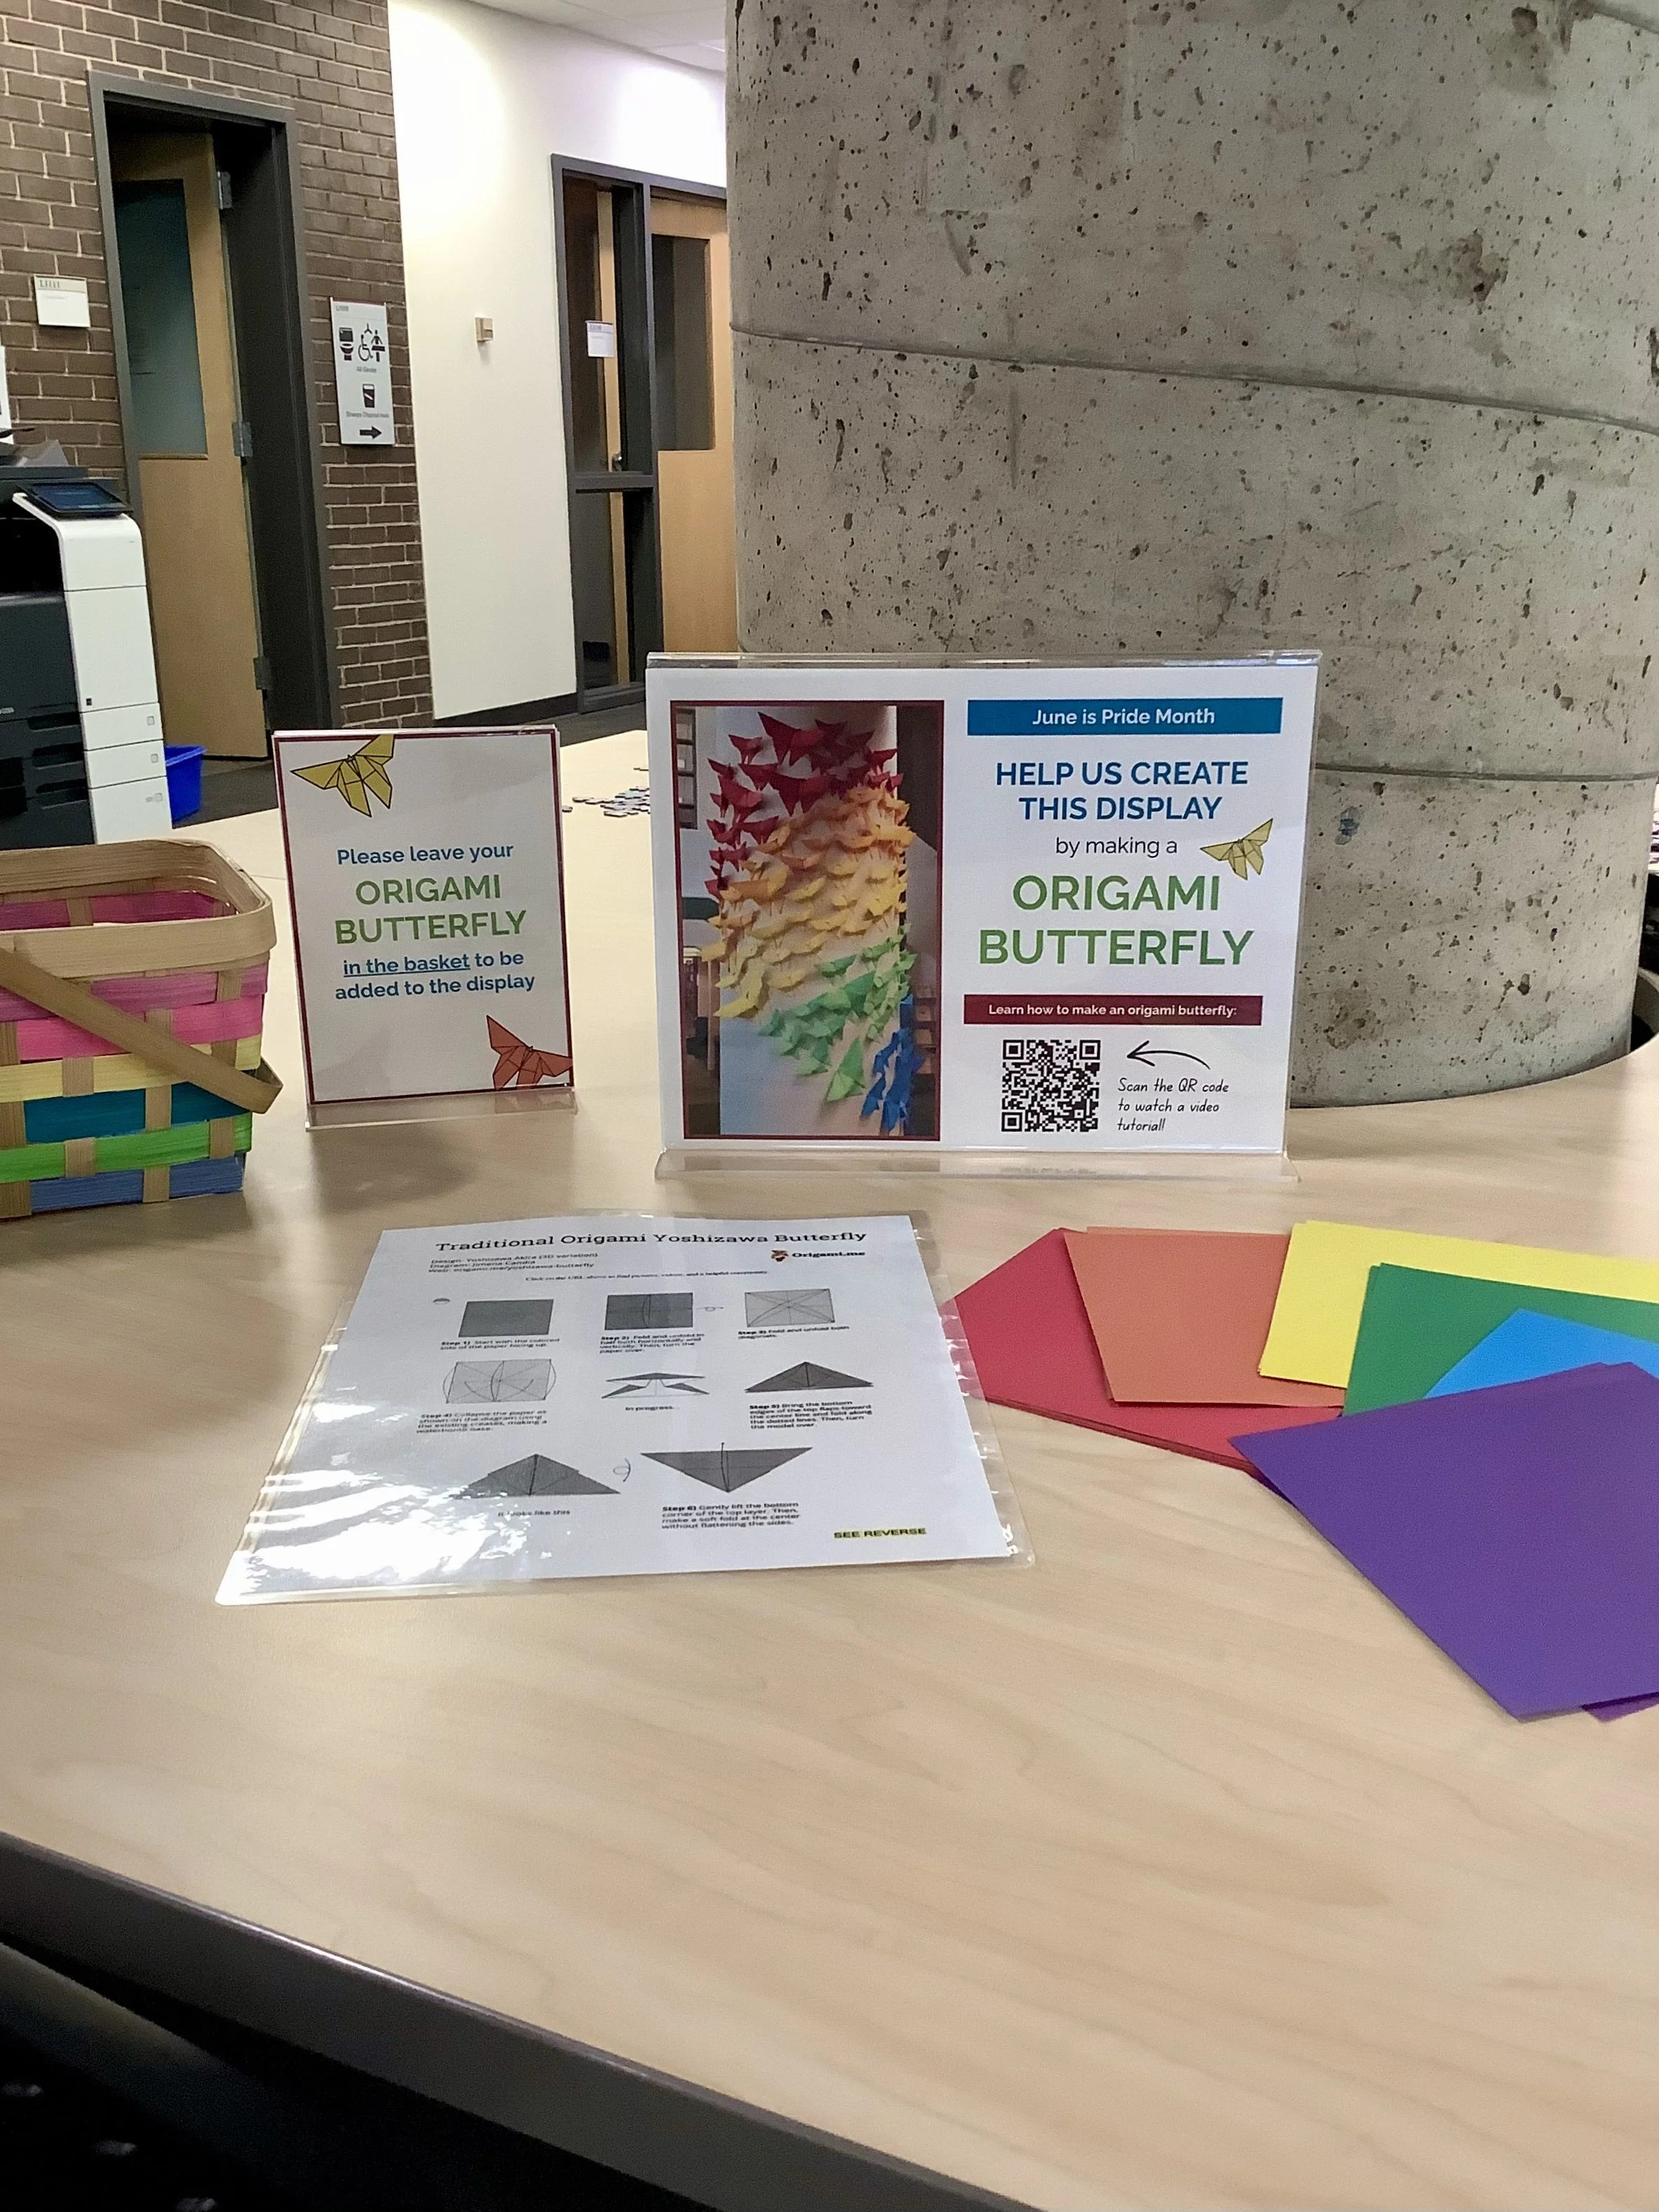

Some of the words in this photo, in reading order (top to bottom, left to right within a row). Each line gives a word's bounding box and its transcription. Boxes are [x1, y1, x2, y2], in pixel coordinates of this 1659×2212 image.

[1032, 710, 1078, 726] June
[1082, 710, 1097, 724] is
[1101, 709, 1151, 724] Pride
[1155, 707, 1215, 724] Month
[996, 762, 1074, 786] HELP
[1082, 761, 1122, 785] US
[1130, 761, 1249, 785] CREATE
[1018, 796, 1087, 820] THIS
[1097, 796, 1222, 820] DISPLAY
[337, 847, 405, 865] Please
[409, 846, 464, 862] leave
[469, 843, 513, 863] your
[1056, 837, 1081, 857] by
[1085, 836, 1159, 857] making
[1165, 841, 1177, 853] a
[356, 874, 501, 905] ORIGAMI
[1013, 875, 1221, 911] ORIGAMI
[334, 910, 527, 944] BUTTERFLY
[979, 929, 1254, 965] BUTTERFLY
[343, 960, 361, 975] in
[365, 957, 399, 974] the
[404, 954, 470, 972] basket
[475, 953, 494, 968] to
[499, 951, 524, 967] be
[335, 980, 399, 1000] added
[404, 980, 425, 996] to
[429, 978, 461, 994] the
[466, 975, 536, 995] display
[989, 1004, 1024, 1015] Learn
[1027, 1004, 1053, 1015] how
[1056, 1005, 1069, 1015] to
[1072, 1004, 1106, 1015] make
[1109, 1007, 1125, 1015] an
[1128, 1004, 1175, 1019] origami
[1178, 1004, 1237, 1019] butterfly:
[1117, 1078, 1148, 1092] Scan
[1153, 1078, 1173, 1092] the
[1178, 1078, 1198, 1094] QR
[1202, 1082, 1229, 1093] code
[1118, 1098, 1130, 1112] to
[1135, 1098, 1172, 1112] watch
[1177, 1104, 1185, 1112] a
[1190, 1098, 1219, 1113] video
[436, 1235, 554, 1251] Traditional
[561, 1234, 646, 1244] Origami
[654, 1234, 768, 1242] Yoshizawa
[774, 1232, 867, 1242] Butterfly
[864, 1528, 926, 1537] REVERSE
